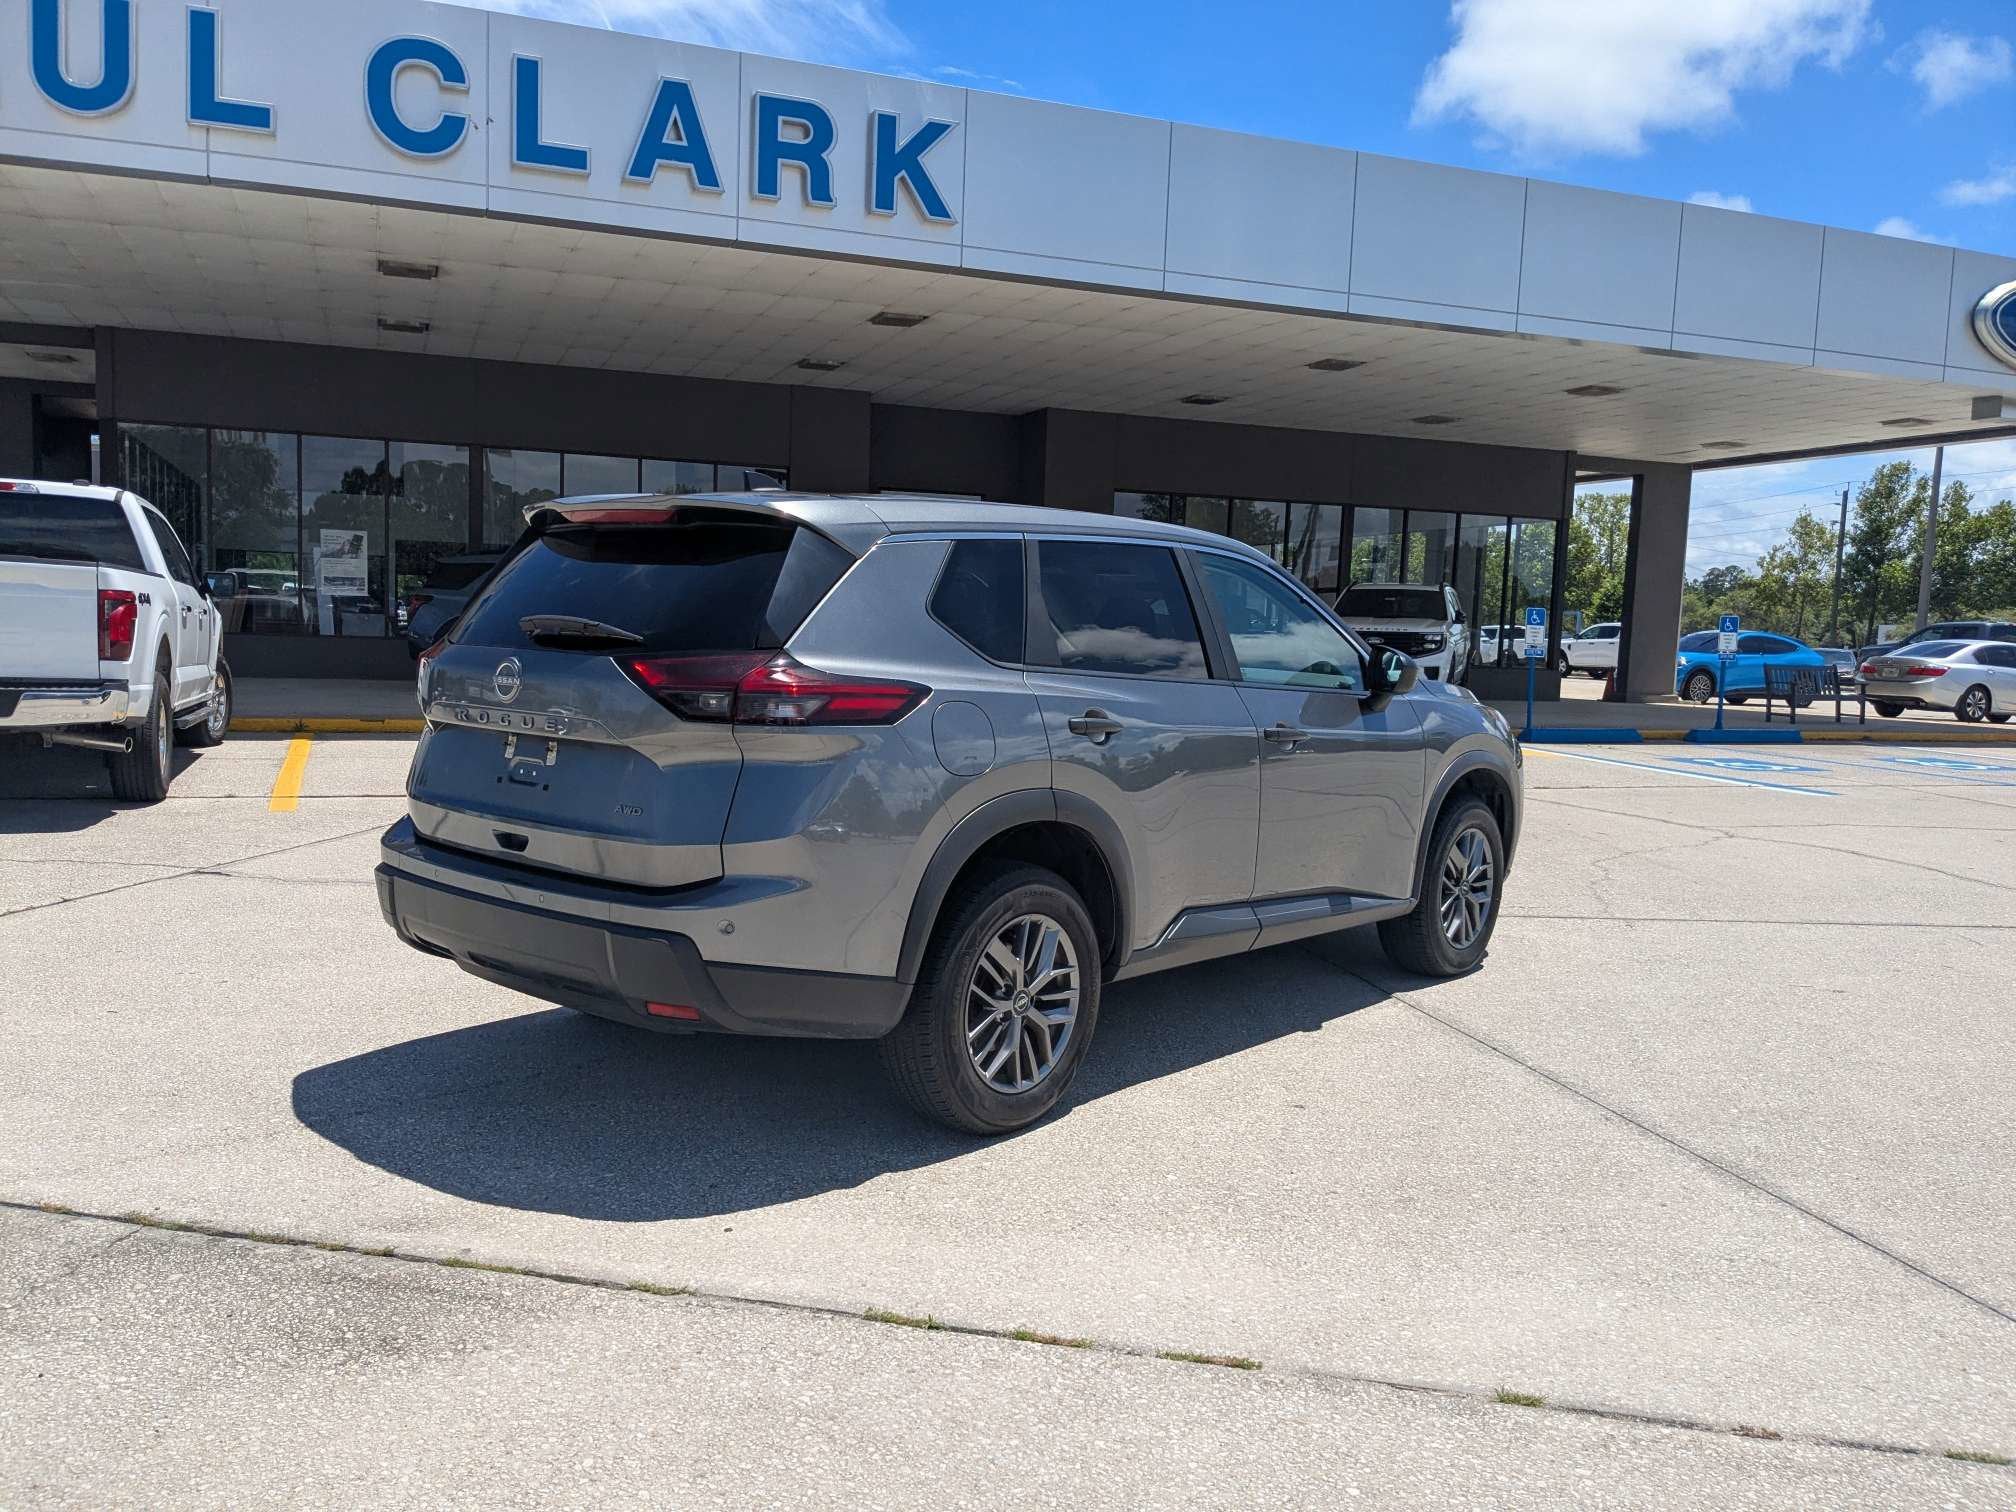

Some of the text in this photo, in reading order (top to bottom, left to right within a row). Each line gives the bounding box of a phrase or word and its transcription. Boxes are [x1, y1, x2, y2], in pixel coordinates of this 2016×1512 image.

[363, 34, 960, 225] CLARK
[455, 707, 559, 732] ROGUE
[614, 801, 644, 817] AWD
